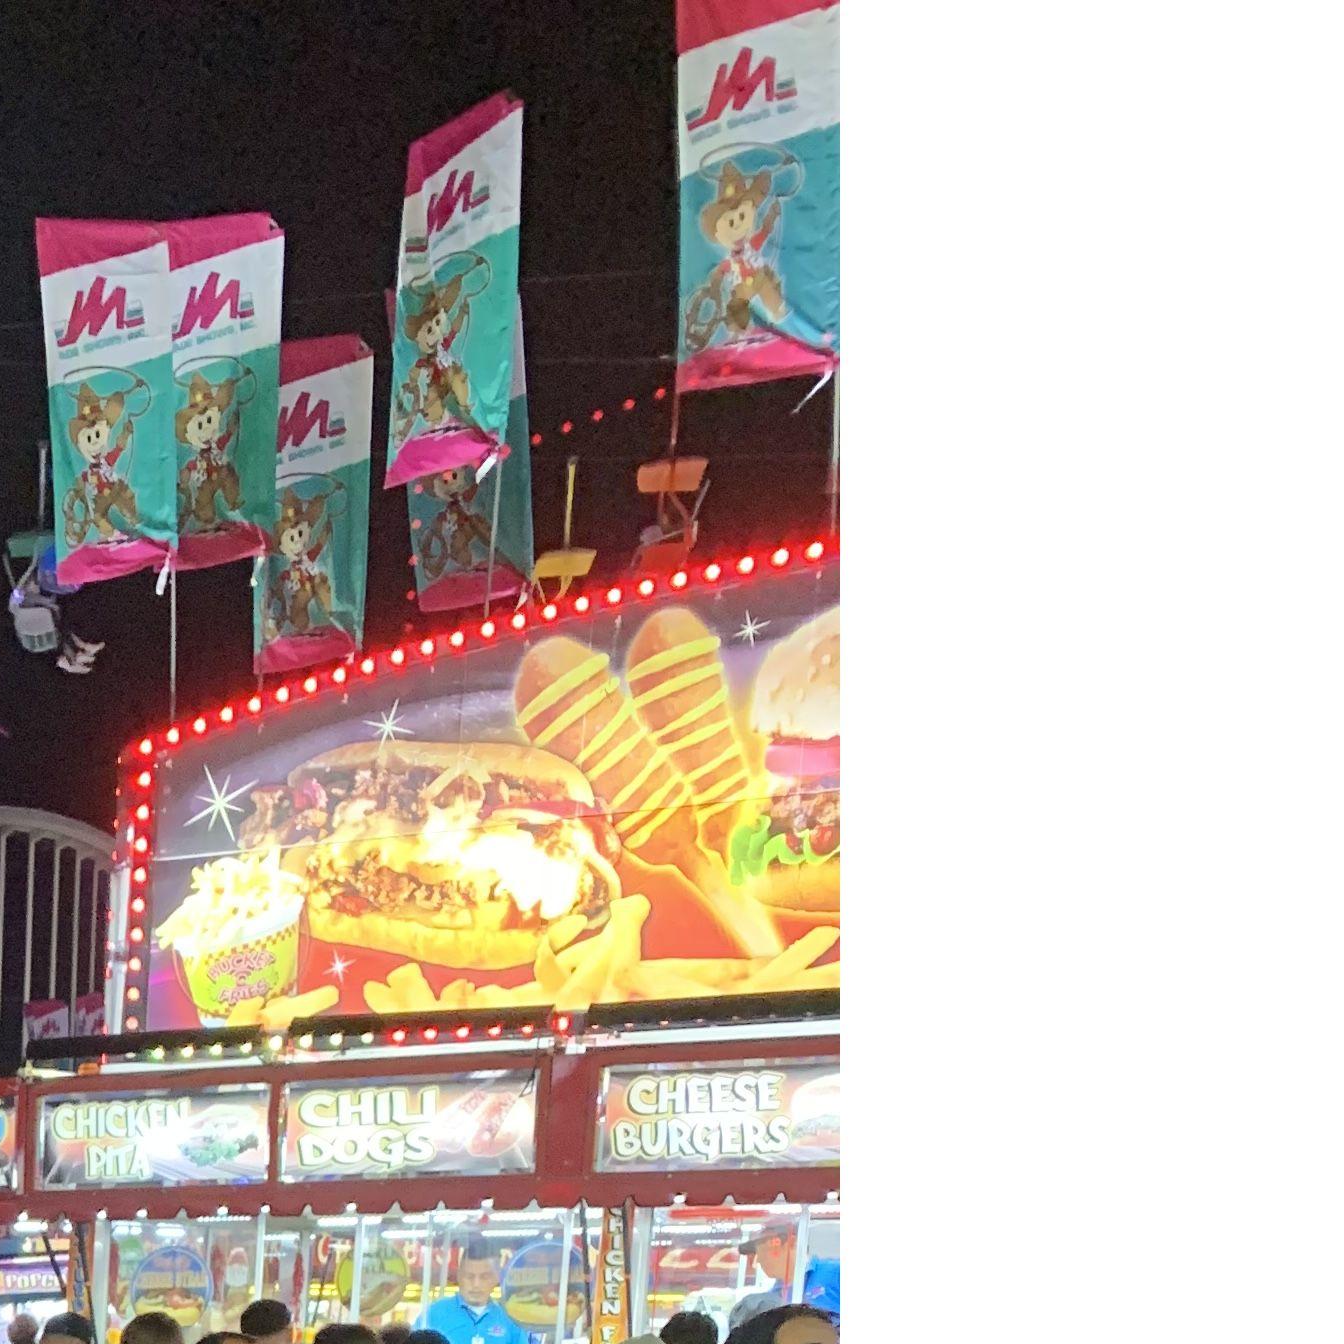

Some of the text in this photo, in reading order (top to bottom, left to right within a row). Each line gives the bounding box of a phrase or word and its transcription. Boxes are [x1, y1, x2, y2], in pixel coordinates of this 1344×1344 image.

[298, 1085, 440, 1129] CHILI
[627, 1072, 786, 1115] CHEESE
[52, 1097, 192, 1141] CHICKEN
[611, 1115, 793, 1162] BURGERS
[85, 1143, 152, 1179] PITA
[297, 1126, 436, 1170] DOGS
